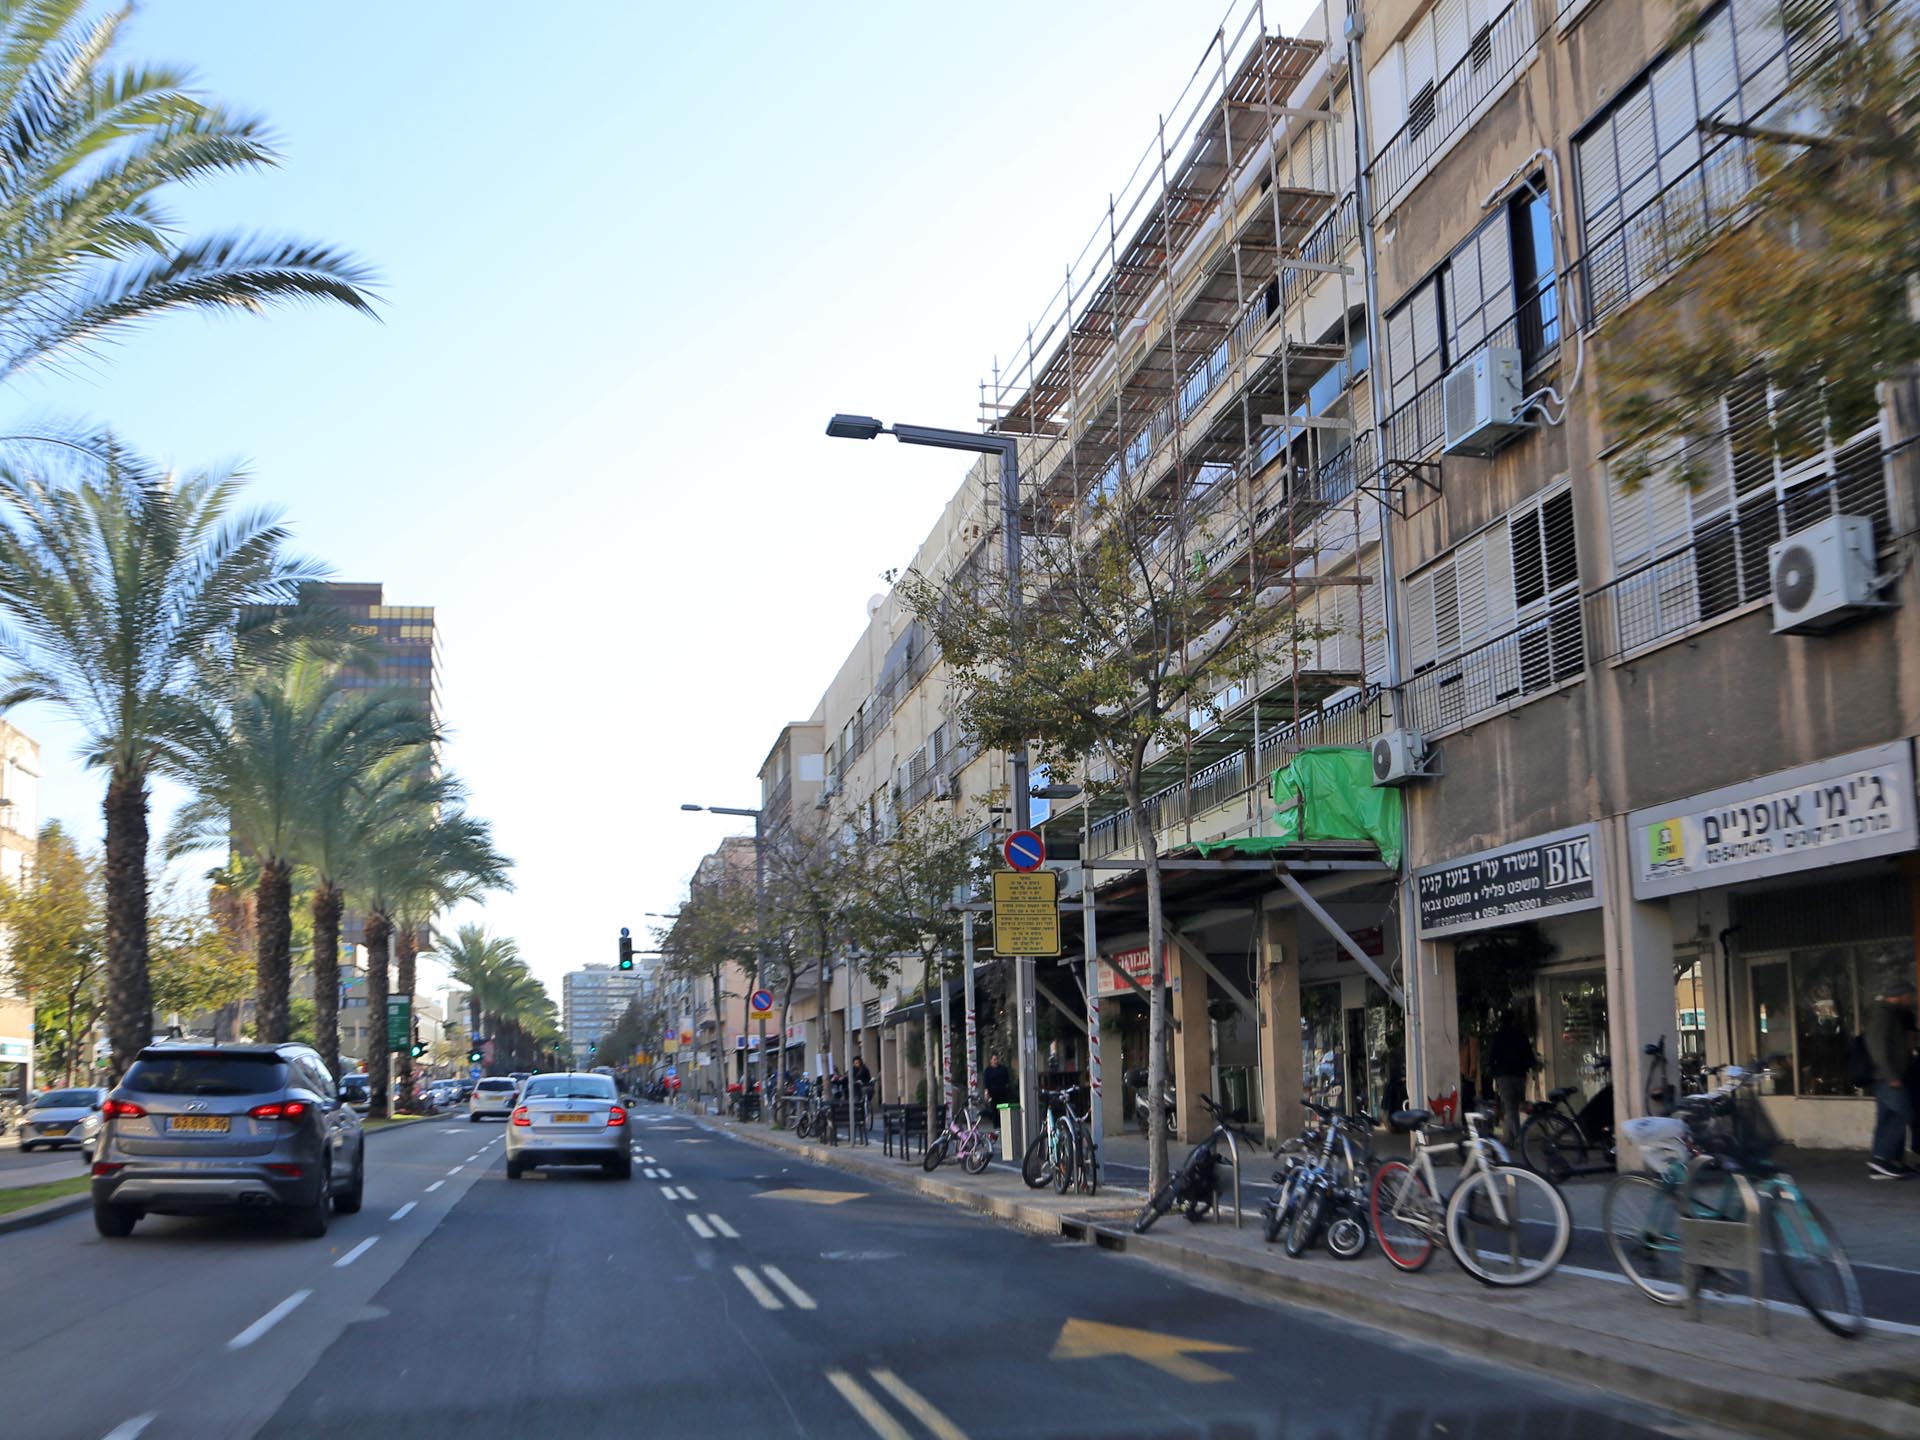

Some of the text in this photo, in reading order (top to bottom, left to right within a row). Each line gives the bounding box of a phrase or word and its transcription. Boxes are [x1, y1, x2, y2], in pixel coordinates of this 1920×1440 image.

[1703, 775, 1887, 845] ג'ימי אופניים
[1503, 850, 1539, 873] משרד
[1546, 841, 1590, 886] BK
[1421, 875, 1442, 894] קניג
[1446, 868, 1470, 888] בועז
[1421, 876, 1540, 912] משפט פלילי משפט צבאי
[1482, 898, 1541, 918] 050-7003001
